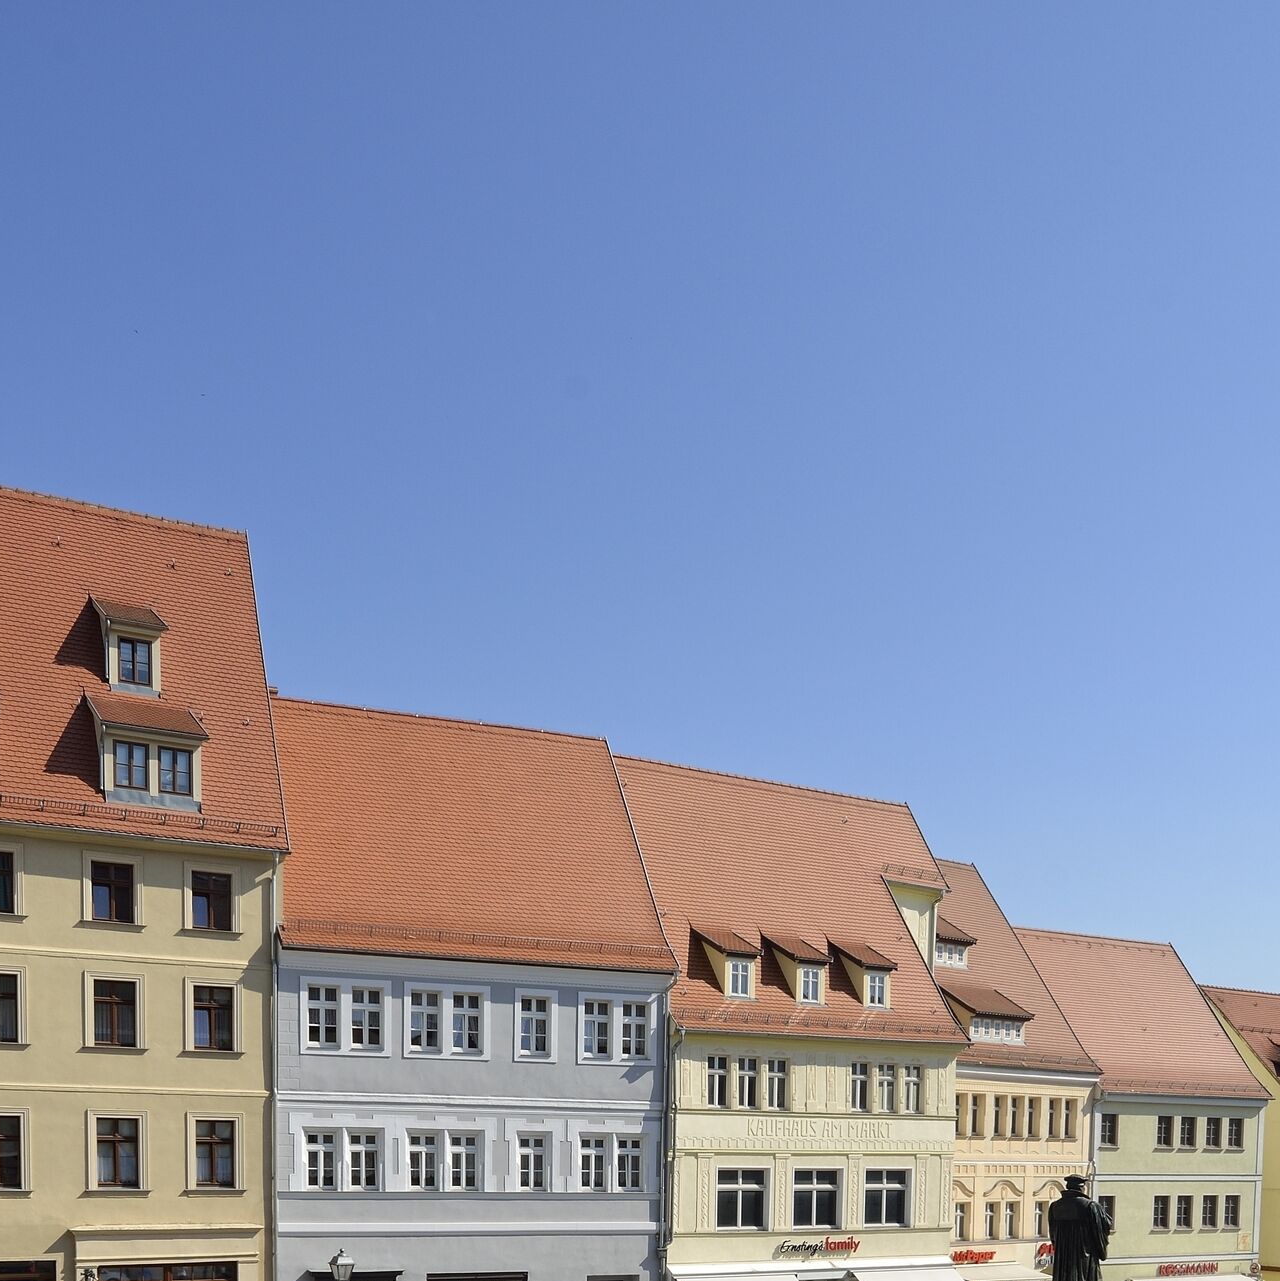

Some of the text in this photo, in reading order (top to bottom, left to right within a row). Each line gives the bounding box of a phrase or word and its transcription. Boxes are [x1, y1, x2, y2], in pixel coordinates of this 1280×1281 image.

[780, 1236, 860, 1256] Ernsting's family
[1158, 1262, 1219, 1276] ROSSMANN
